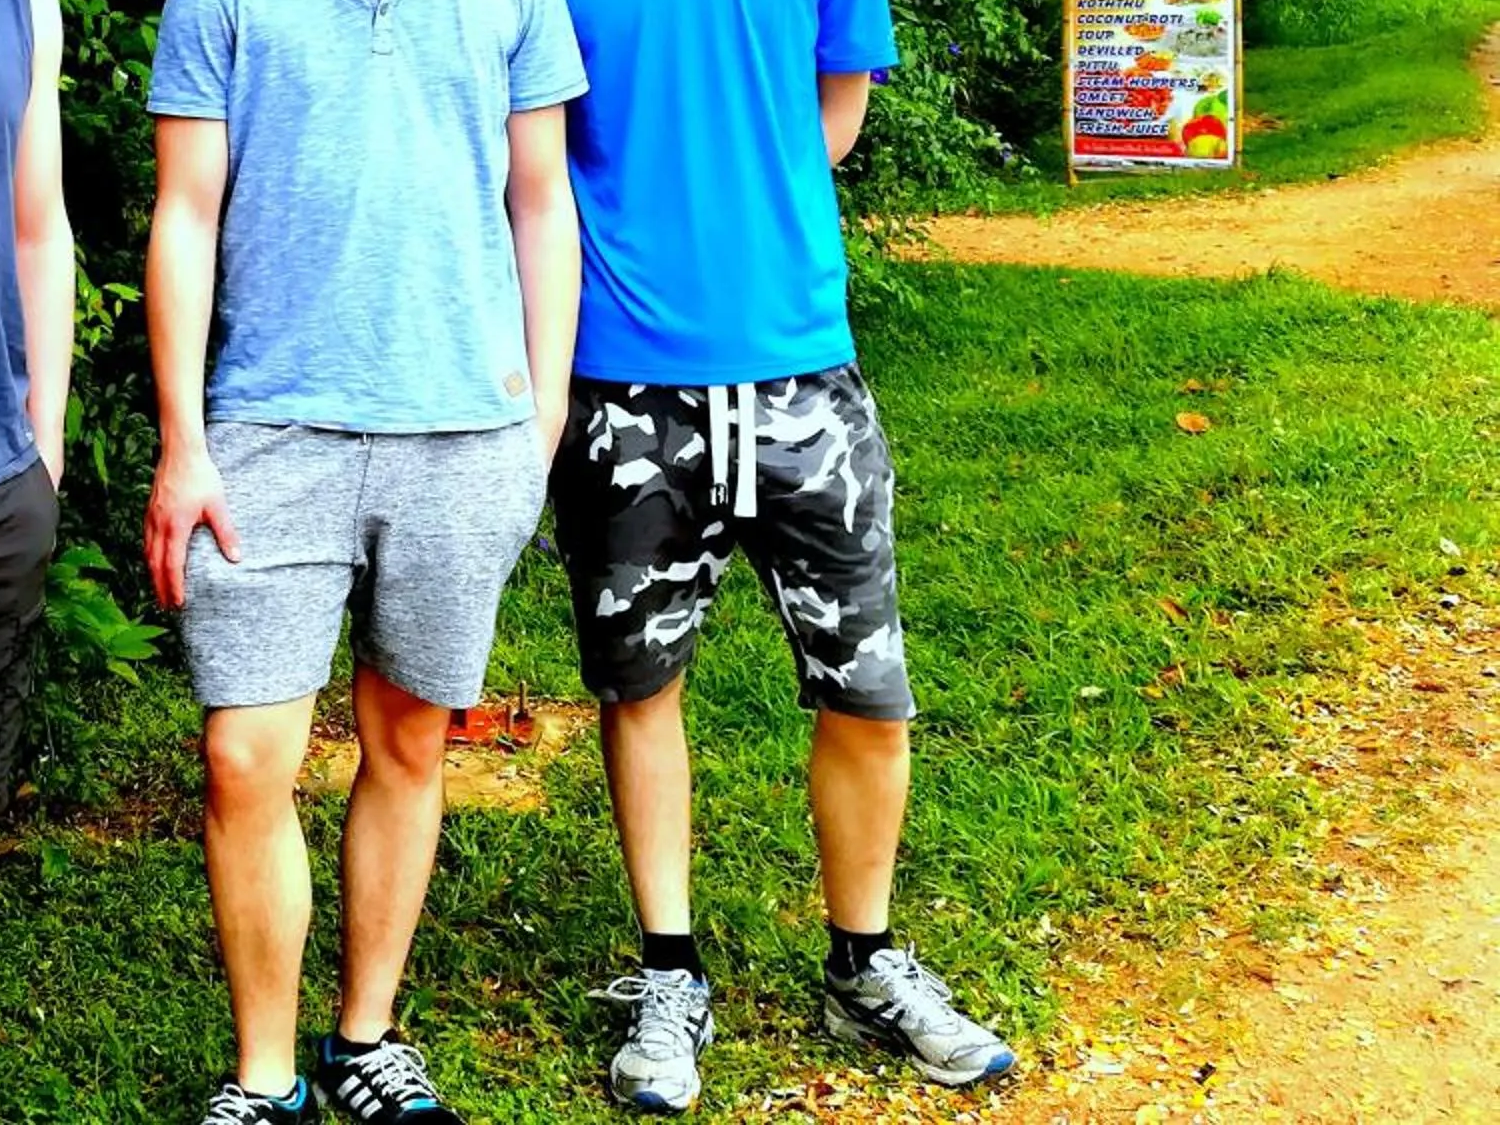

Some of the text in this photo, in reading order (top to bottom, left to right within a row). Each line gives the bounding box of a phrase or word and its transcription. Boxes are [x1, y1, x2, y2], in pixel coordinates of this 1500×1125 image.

[1076, 14, 1184, 24] COCONUT ROTI
[1076, 30, 1115, 40] SOUP
[1076, 45, 1145, 56] DEVILLED
[1076, 108, 1154, 118] SANDWICH
[1077, 124, 1169, 134] FRESH JUICE
